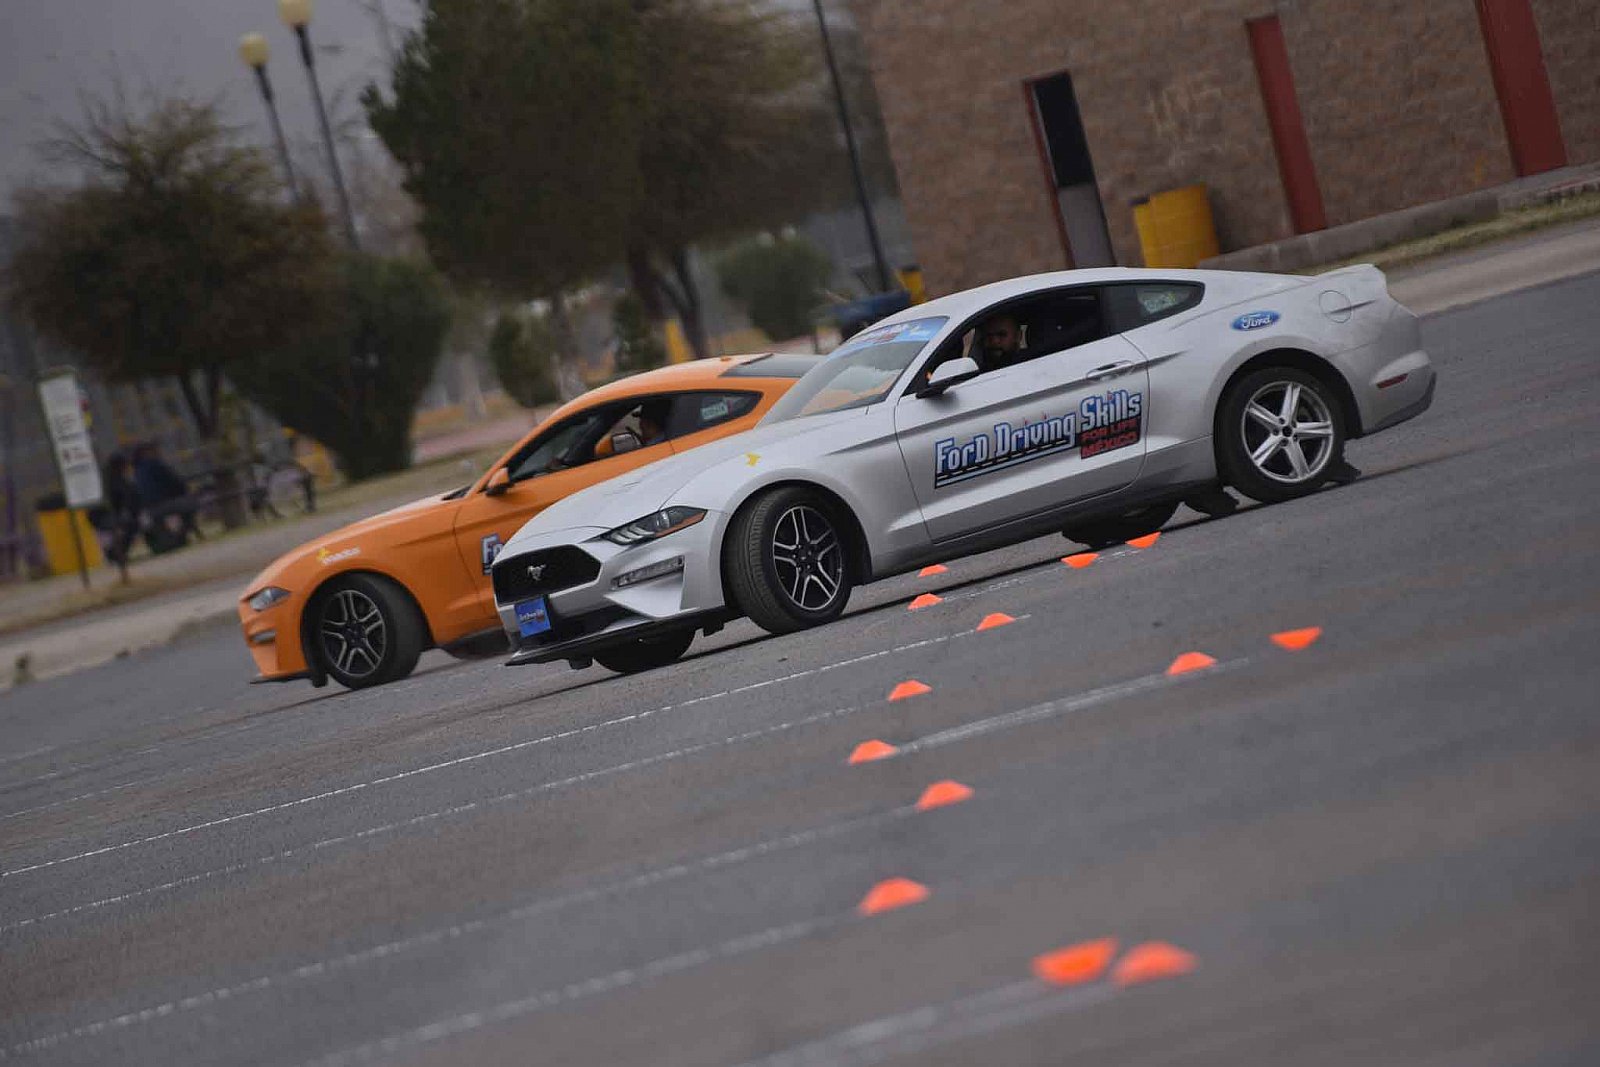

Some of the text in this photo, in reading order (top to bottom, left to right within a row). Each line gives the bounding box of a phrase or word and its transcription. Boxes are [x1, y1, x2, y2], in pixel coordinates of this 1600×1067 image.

[1242, 313, 1271, 329] Ford
[995, 411, 1077, 459] Driving
[1080, 389, 1143, 430] Skills
[1081, 427, 1108, 442] FOR
